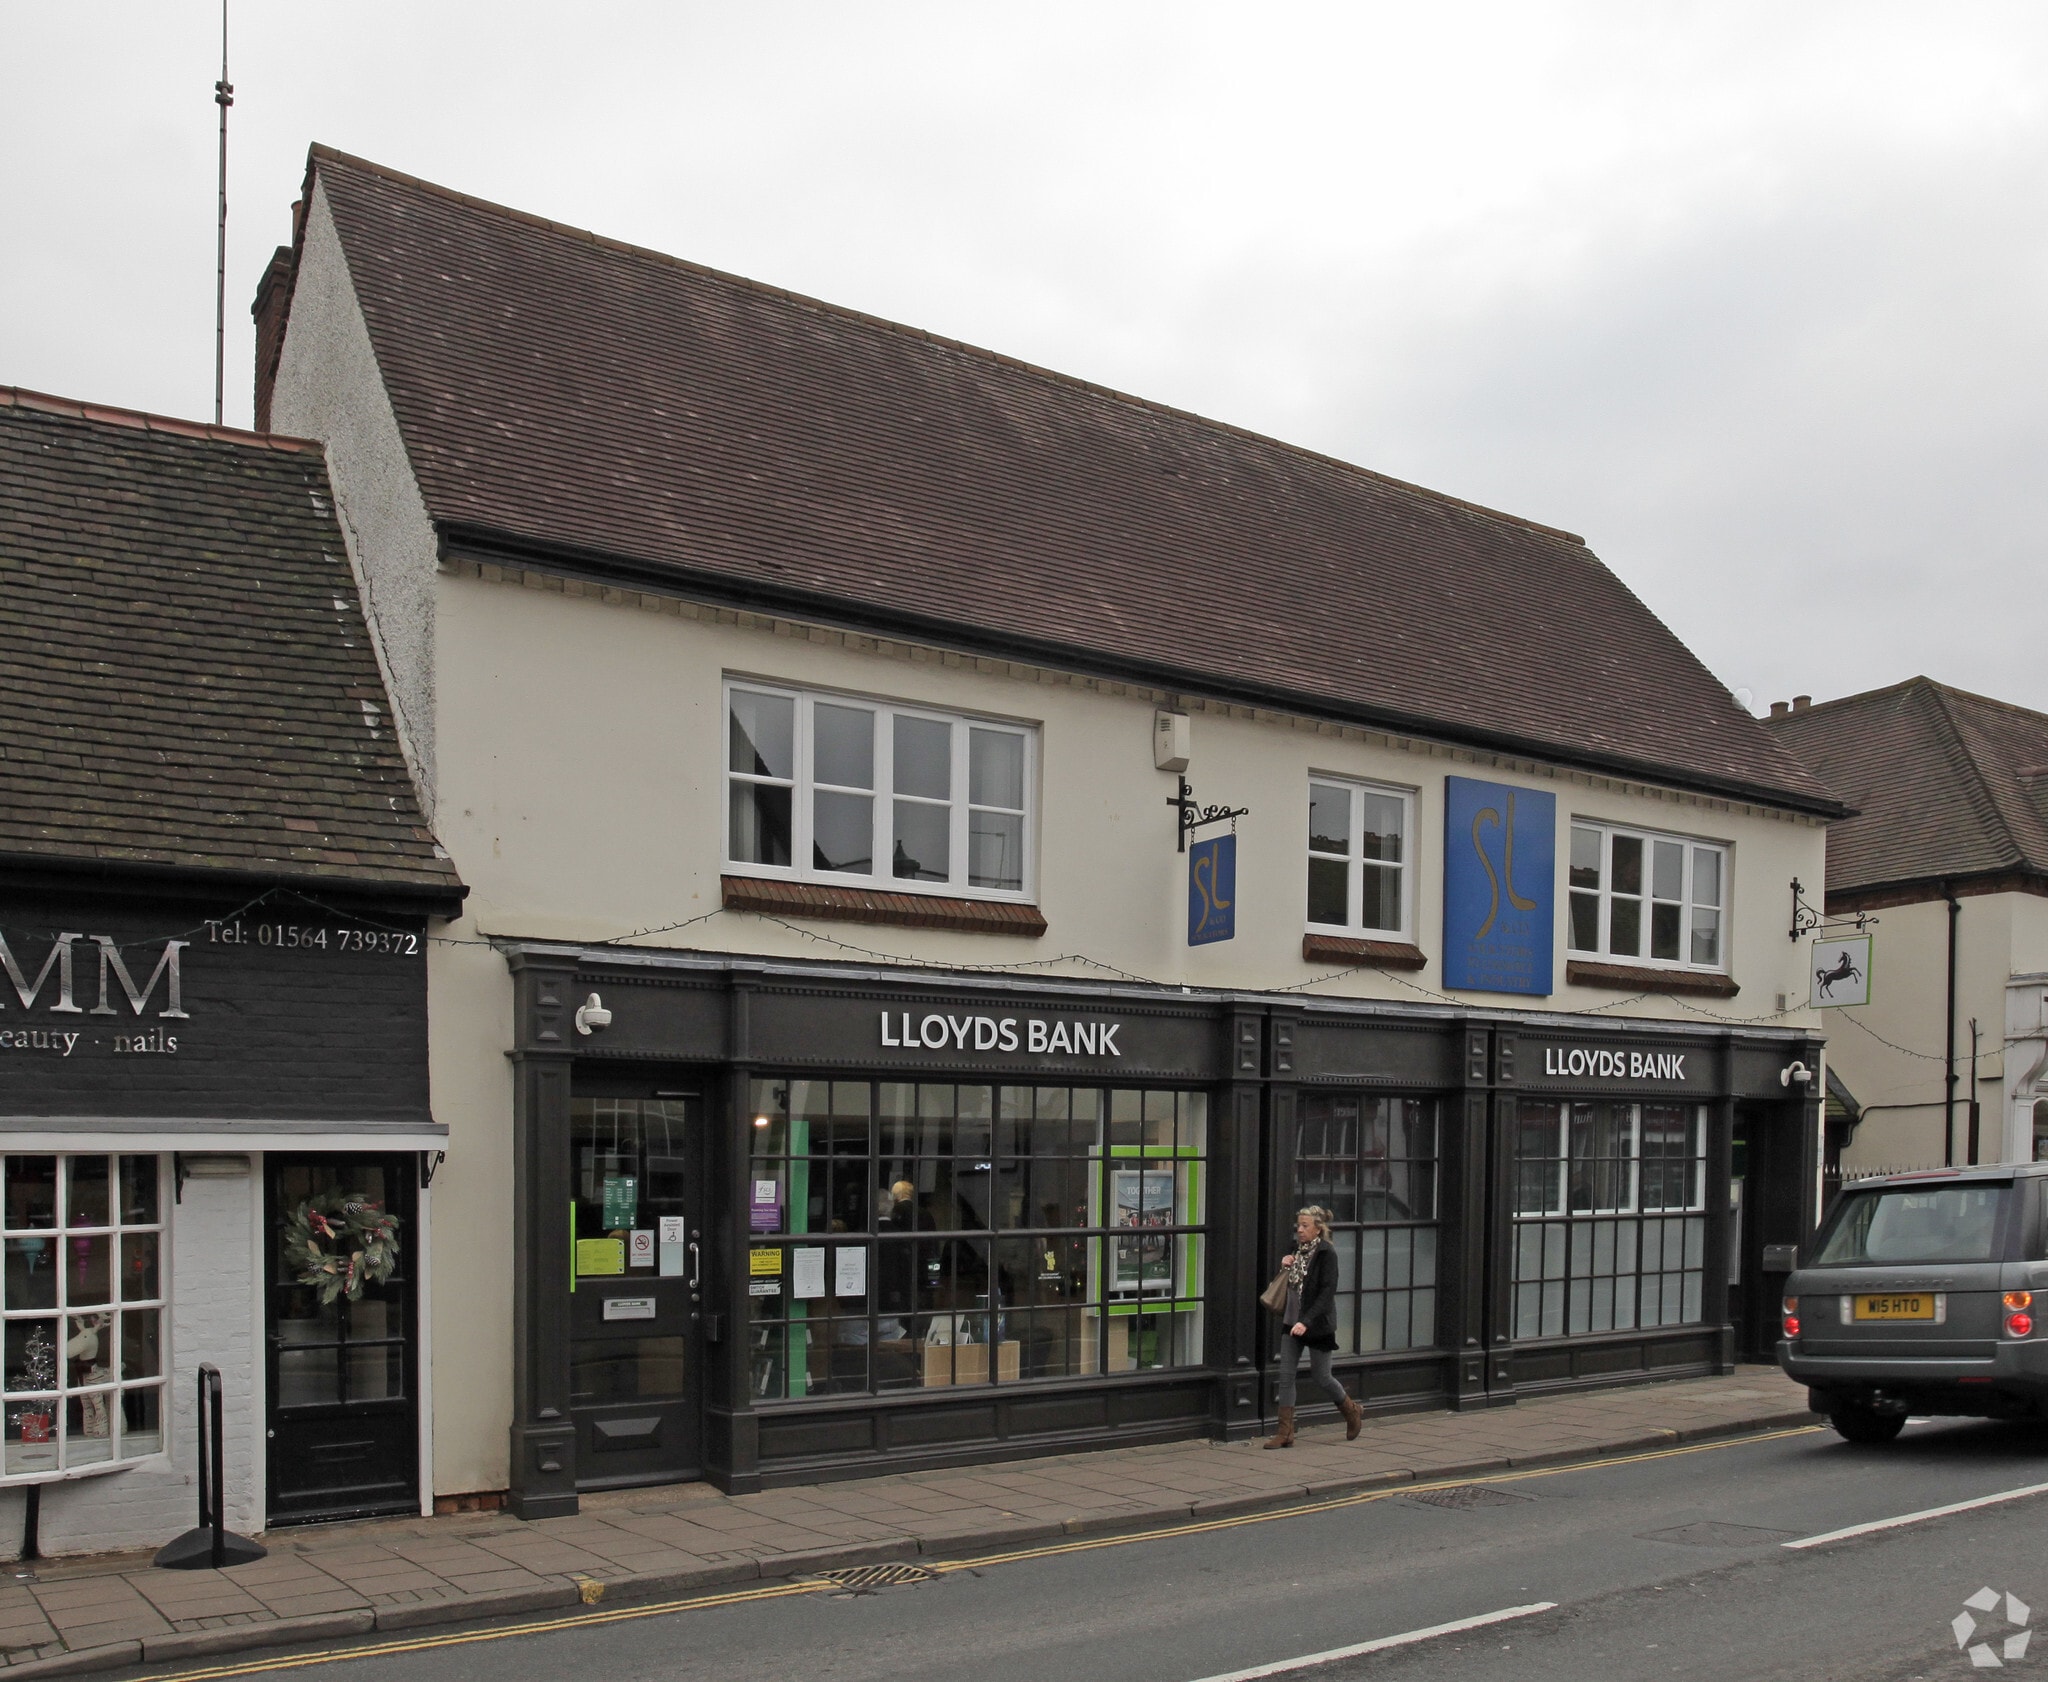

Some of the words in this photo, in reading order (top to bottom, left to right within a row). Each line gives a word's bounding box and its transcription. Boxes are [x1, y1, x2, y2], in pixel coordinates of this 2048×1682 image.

[1193, 842, 1231, 934] SL
[204, 920, 247, 945] Tel:
[257, 924, 328, 949] 01564
[337, 928, 419, 956] 739372
[0, 1029, 79, 1056] eauty
[113, 1026, 178, 1054] nails
[881, 1011, 1019, 1052] LLOYDS
[1028, 1019, 1121, 1056] BANK
[1546, 1048, 1625, 1077] LLOYDS
[1630, 1052, 1685, 1080] BANK
[1126, 1186, 1162, 1195] TOGTHER
[1892, 1298, 1920, 1313] HTO
